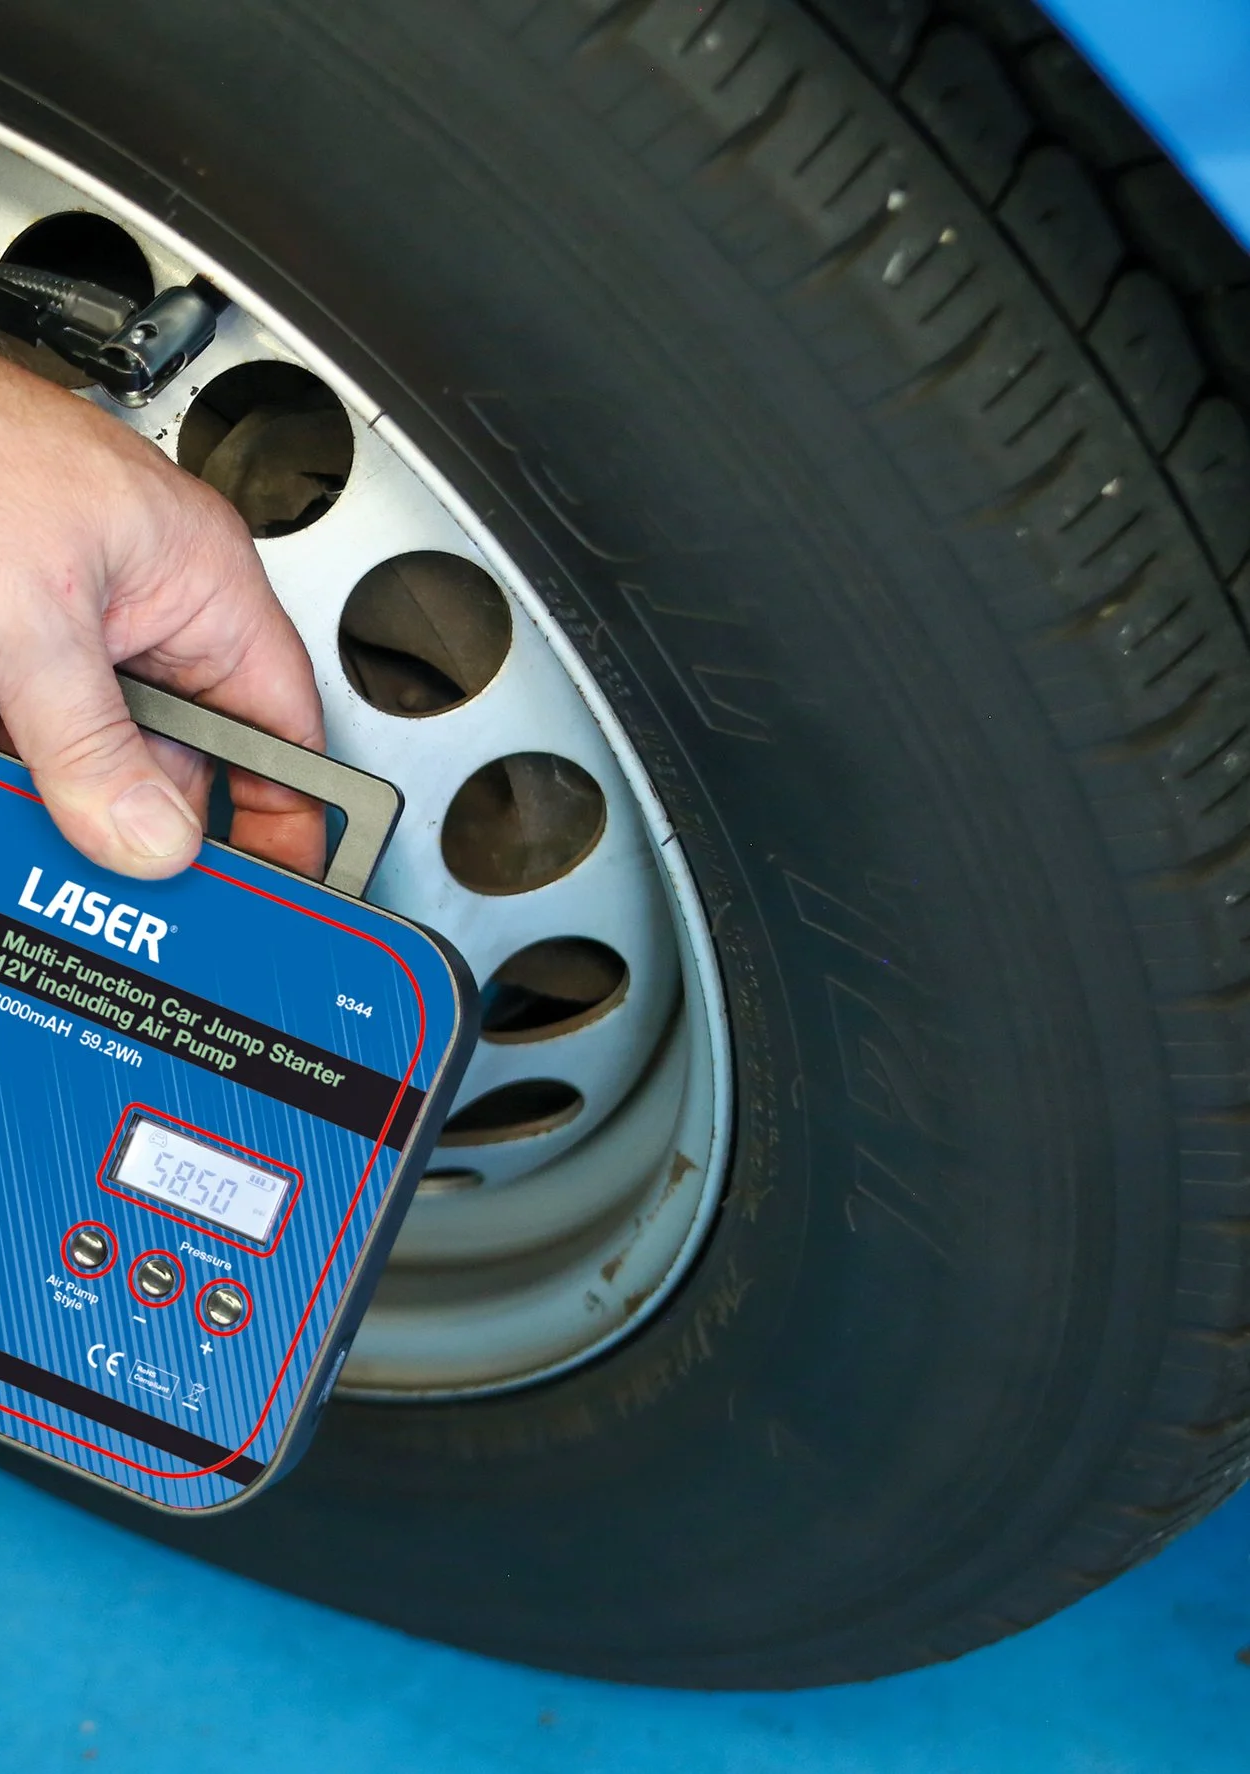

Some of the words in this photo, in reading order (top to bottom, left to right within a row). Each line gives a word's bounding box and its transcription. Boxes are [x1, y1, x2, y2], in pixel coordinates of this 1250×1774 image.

[1, 929, 156, 1010] Multi-Function
[161, 997, 202, 1027] Car
[203, 1017, 265, 1056] Jump
[269, 1043, 346, 1088] Starter
[36, 970, 135, 1030] including
[136, 1015, 172, 1041] Air
[172, 1028, 237, 1071] Pump
[335, 994, 373, 1019] 9344
[79, 1030, 143, 1068] 59.2Wh
[179, 1241, 232, 1271] Pressure
[46, 1274, 64, 1288] Air
[65, 1282, 99, 1305] Pump
[53, 1290, 83, 1310] Style
[87, 1343, 125, 1377] CE
[134, 1373, 170, 1393] Compliant
